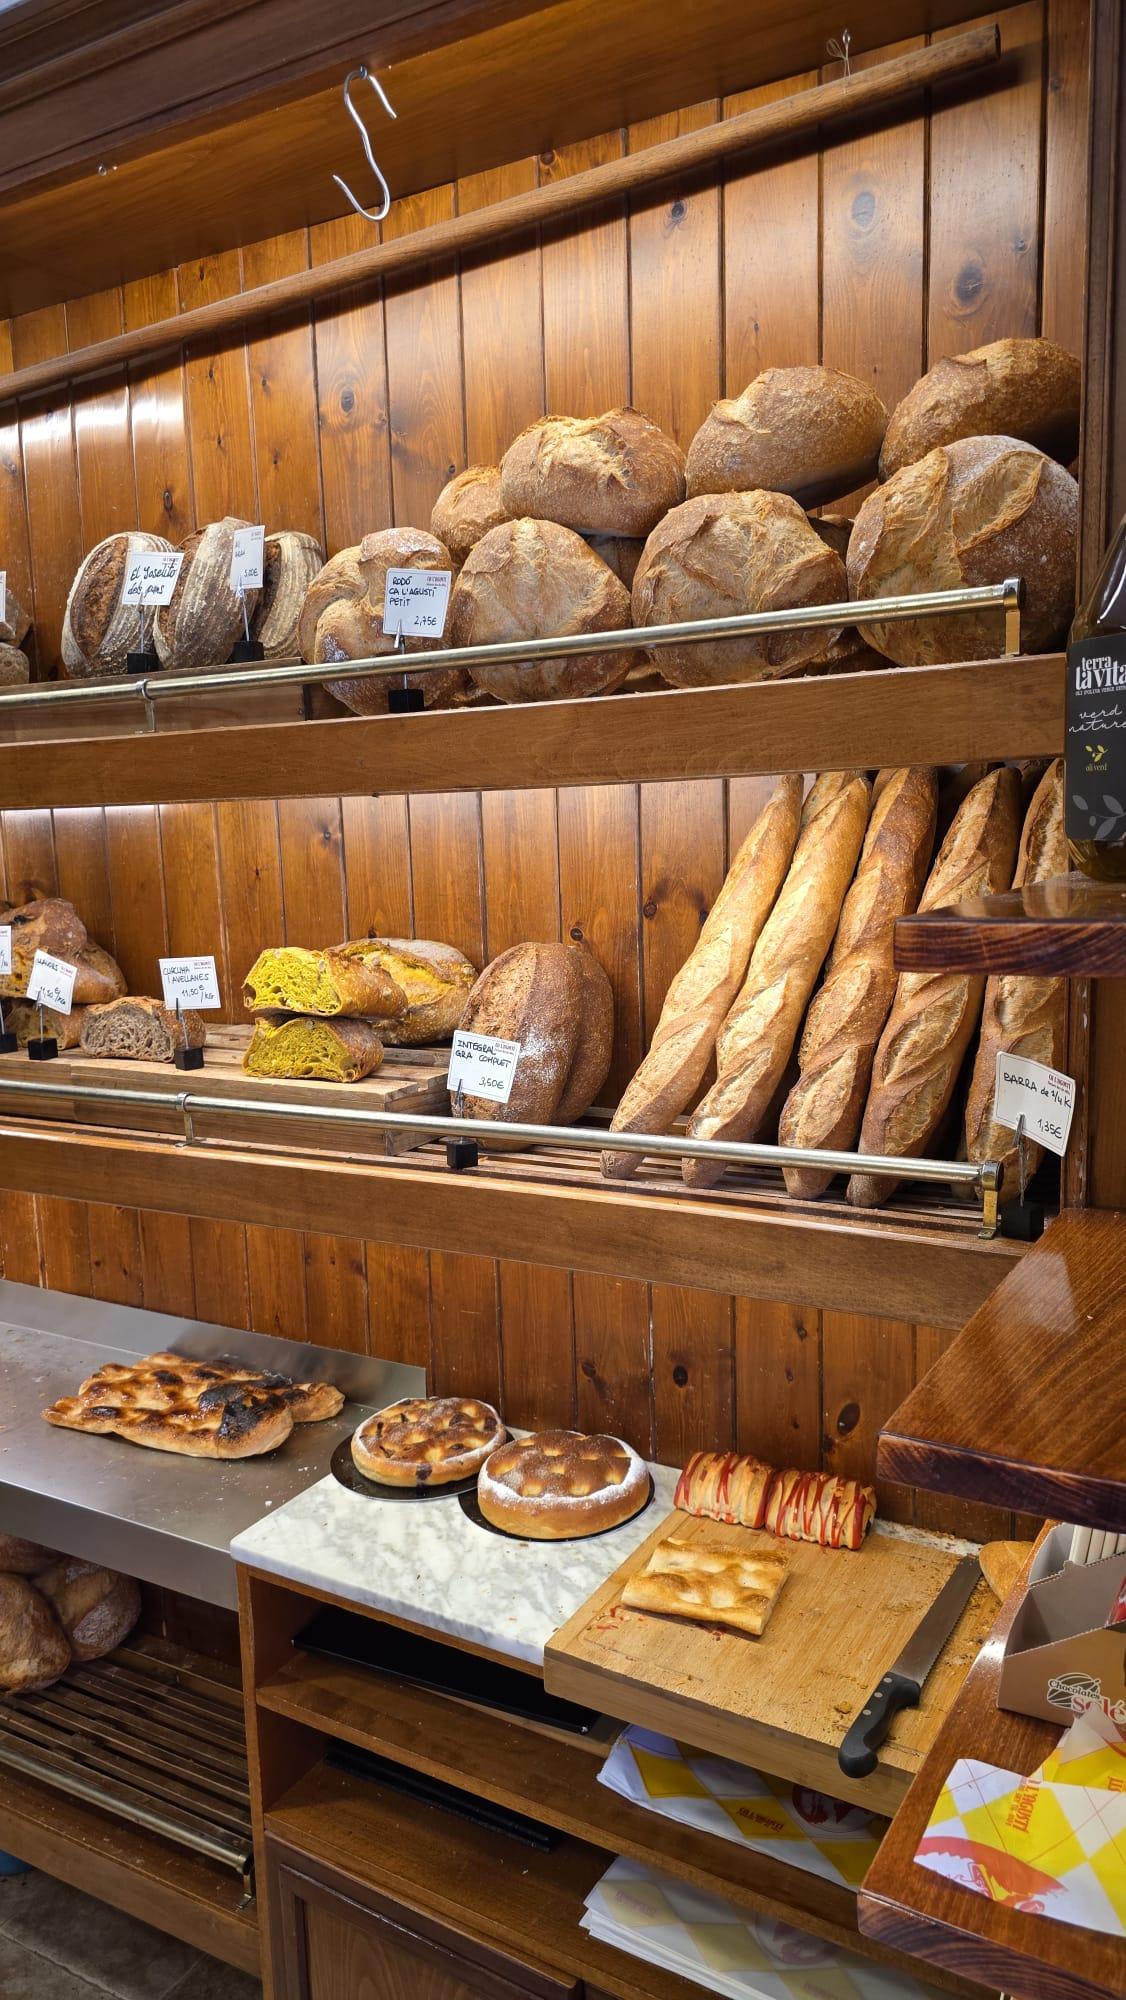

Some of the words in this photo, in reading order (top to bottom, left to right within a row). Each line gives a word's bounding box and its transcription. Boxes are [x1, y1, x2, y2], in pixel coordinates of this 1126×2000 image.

[388, 588, 399, 596] CA
[1081, 656, 1112, 672] terra
[1078, 704, 1123, 720] verd
[457, 1039, 497, 1056] INTEGRAL
[1003, 1072, 1038, 1092] BARRA
[1040, 1086, 1050, 1098] de
[1049, 1680, 1100, 1700] Chocolates
